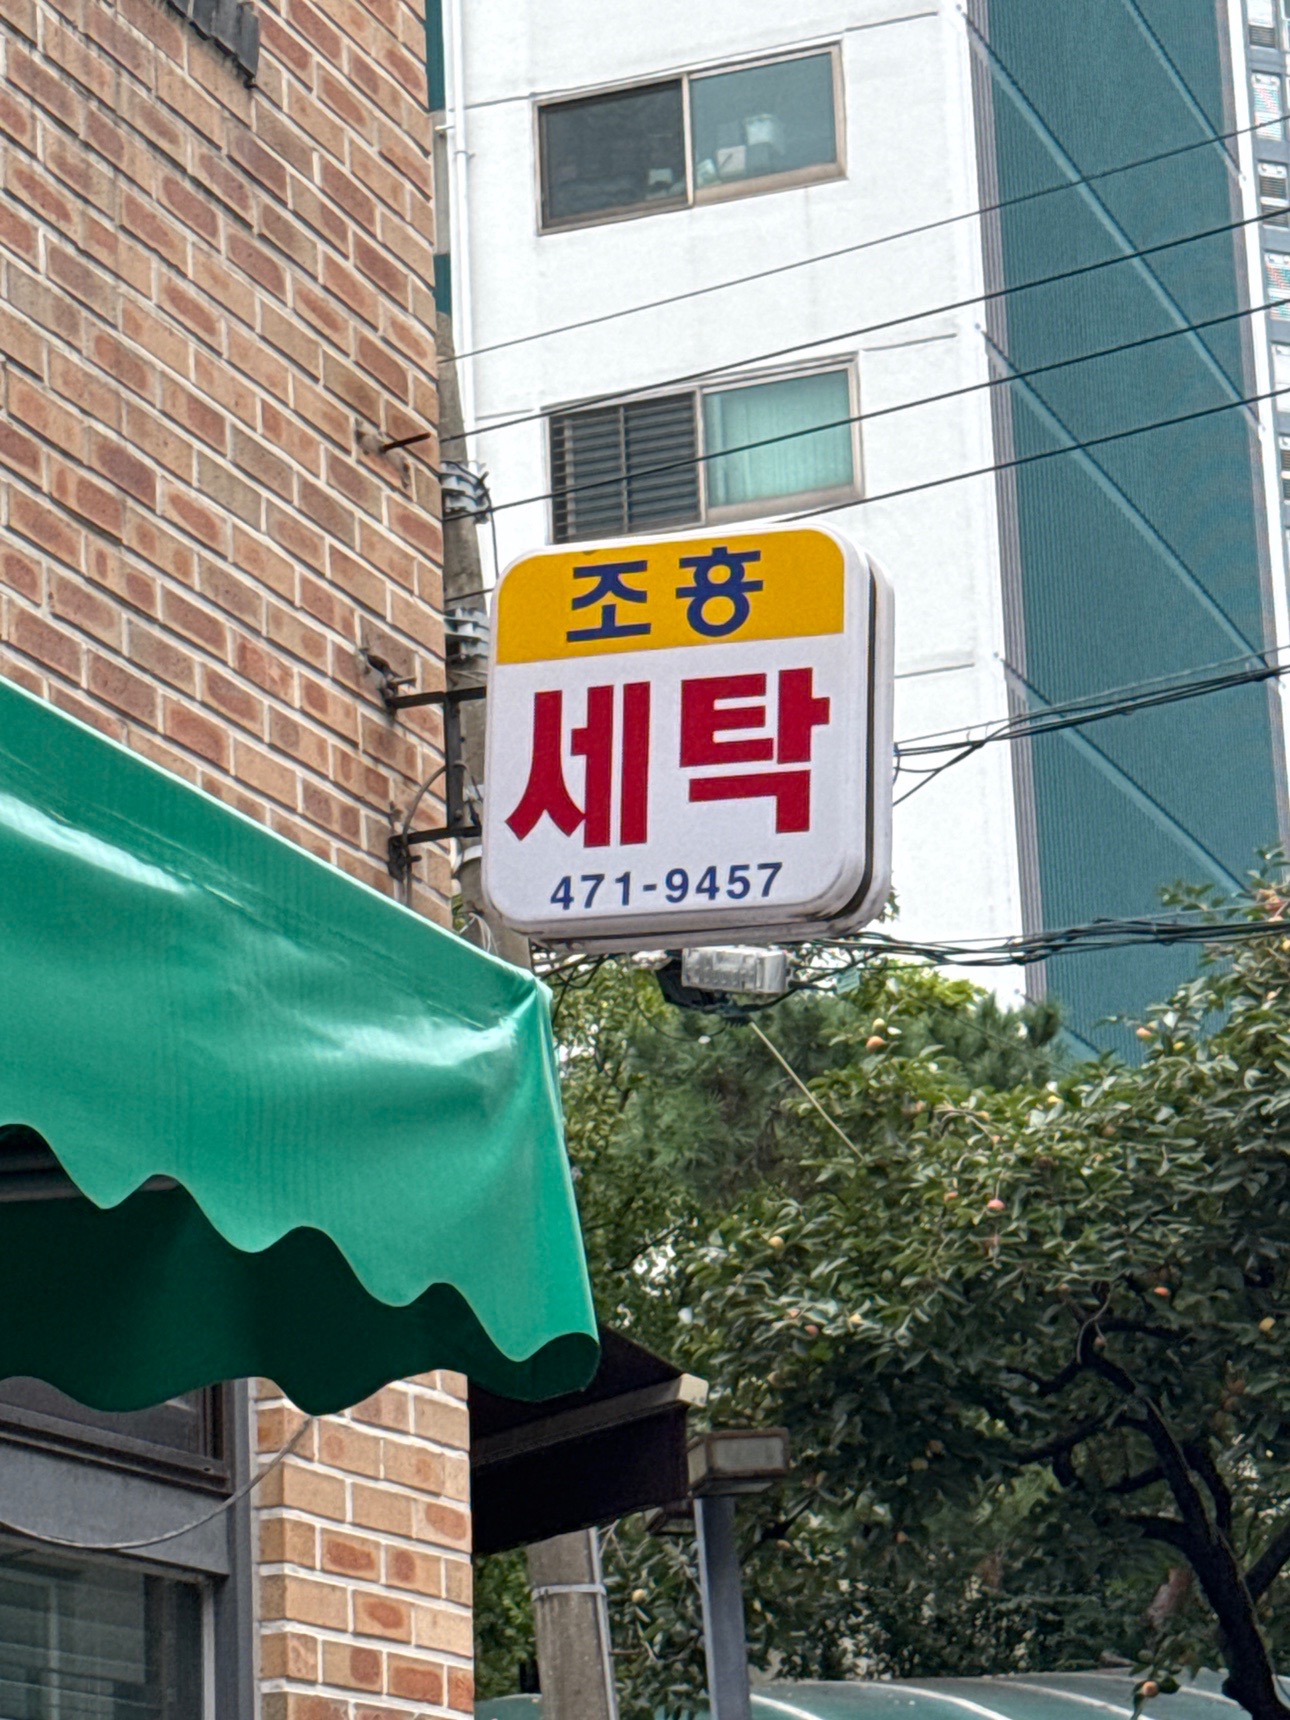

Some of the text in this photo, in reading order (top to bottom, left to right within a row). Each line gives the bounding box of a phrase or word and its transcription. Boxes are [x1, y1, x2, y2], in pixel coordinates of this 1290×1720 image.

[566, 545, 764, 643] 조흥
[504, 667, 831, 848] 세탁
[550, 861, 784, 910] 471-9457
